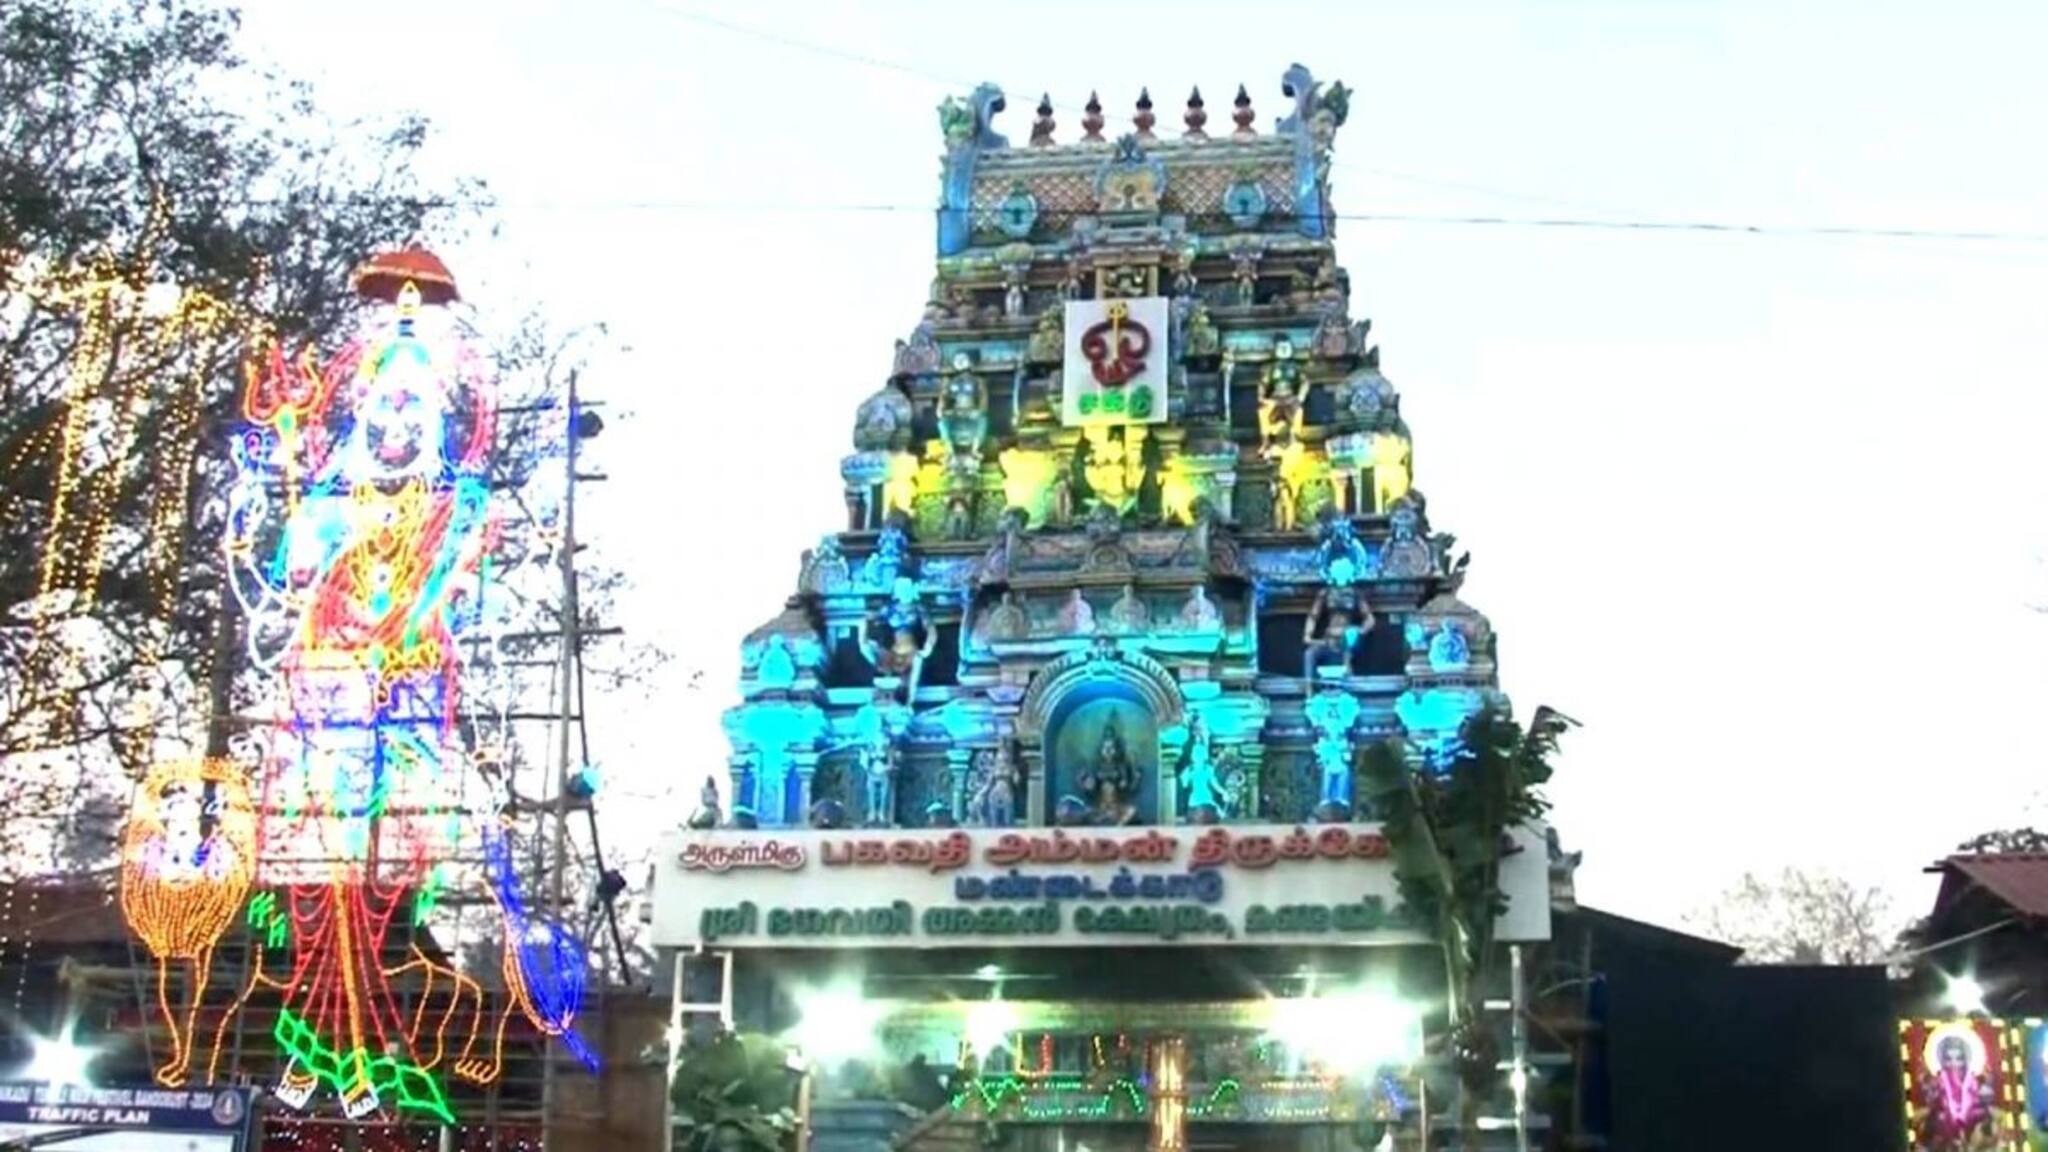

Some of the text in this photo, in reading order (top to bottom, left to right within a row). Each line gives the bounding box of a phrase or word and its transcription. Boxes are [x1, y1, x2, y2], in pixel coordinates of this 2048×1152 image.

[679, 840, 806, 872] அருள்மிகு
[822, 833, 970, 873] பகவதி
[984, 829, 1179, 866] அம்மன்
[954, 866, 1224, 904] மண்டைக்காடு
[27, 1106, 150, 1125] TRAFFIC PLAN
